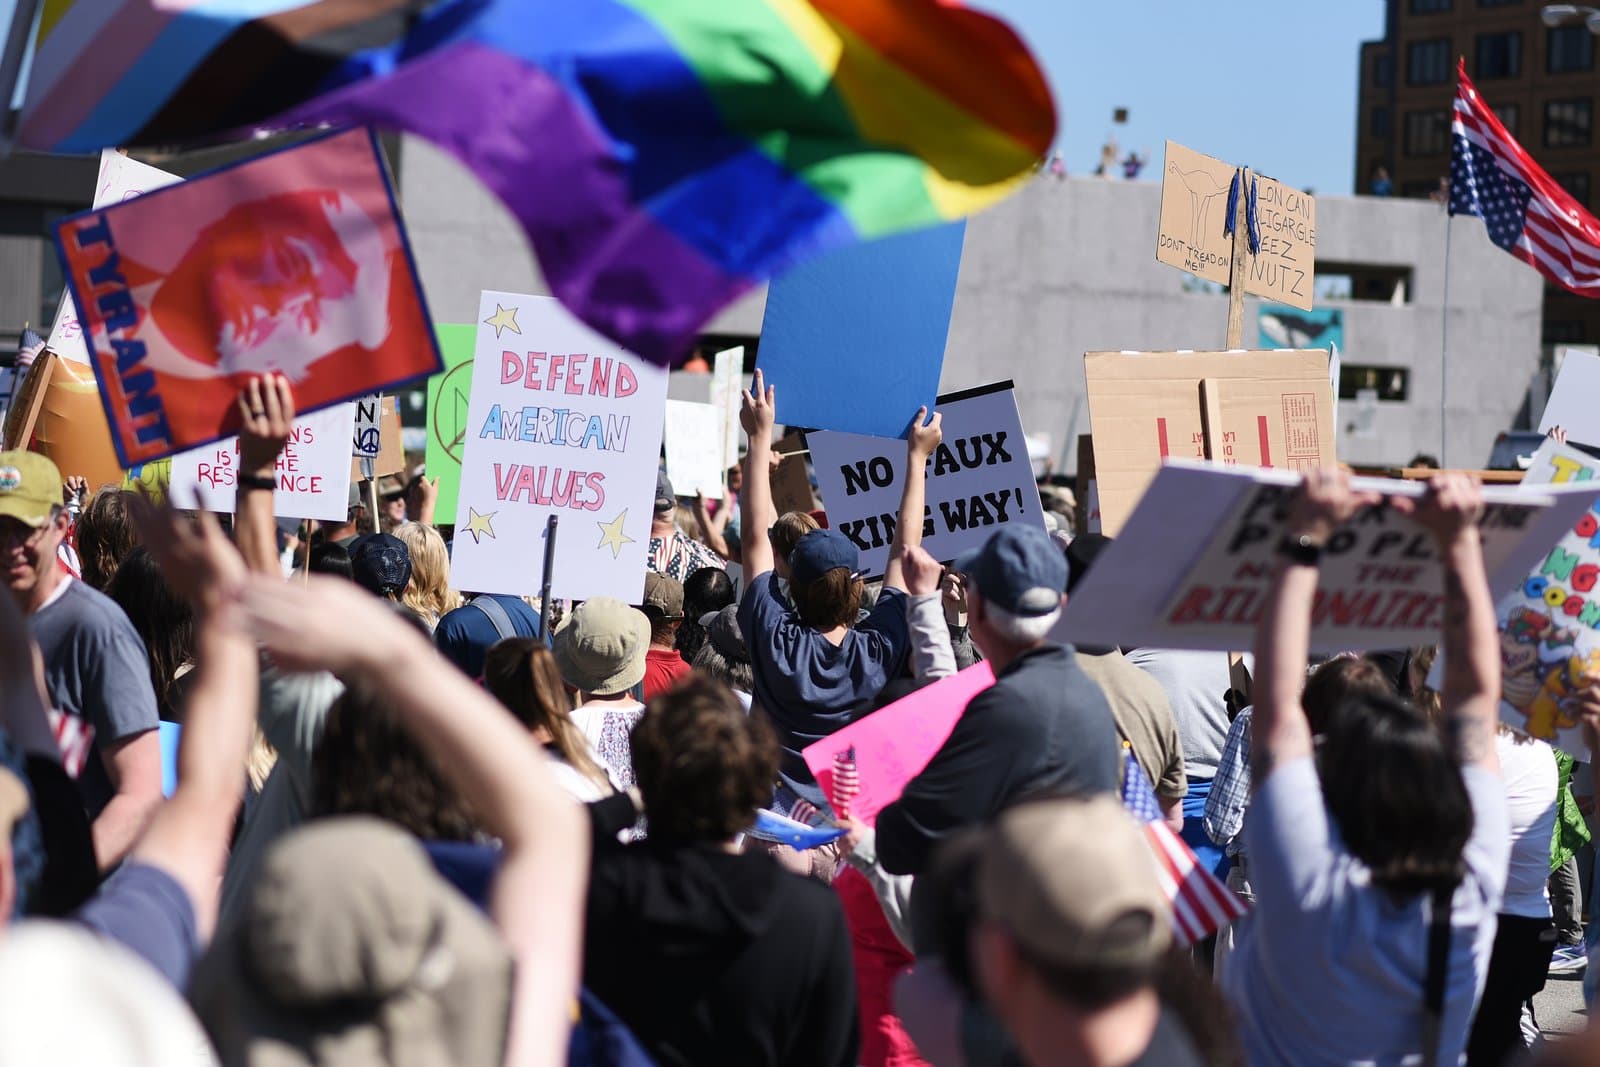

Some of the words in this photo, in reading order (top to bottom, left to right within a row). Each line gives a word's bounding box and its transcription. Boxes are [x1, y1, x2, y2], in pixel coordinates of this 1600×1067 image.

[1257, 176, 1283, 208] LON
[1286, 193, 1310, 220] CAN
[1259, 207, 1316, 247] LIGARGLE
[1261, 235, 1297, 262] EEZ
[1160, 234, 1185, 249] DONT
[1187, 246, 1216, 264] TREAD
[1217, 256, 1229, 267] ON
[1250, 260, 1305, 297] NUTZ
[77, 212, 172, 448] TYRANT
[500, 350, 639, 398] DEFEND
[479, 404, 631, 452] AMERICAN
[216, 450, 231, 466] IS
[274, 459, 300, 472] HE
[840, 456, 894, 496] NO
[924, 431, 1013, 479] AUX
[493, 463, 606, 512] VALUES
[939, 488, 1025, 533] WAY!
